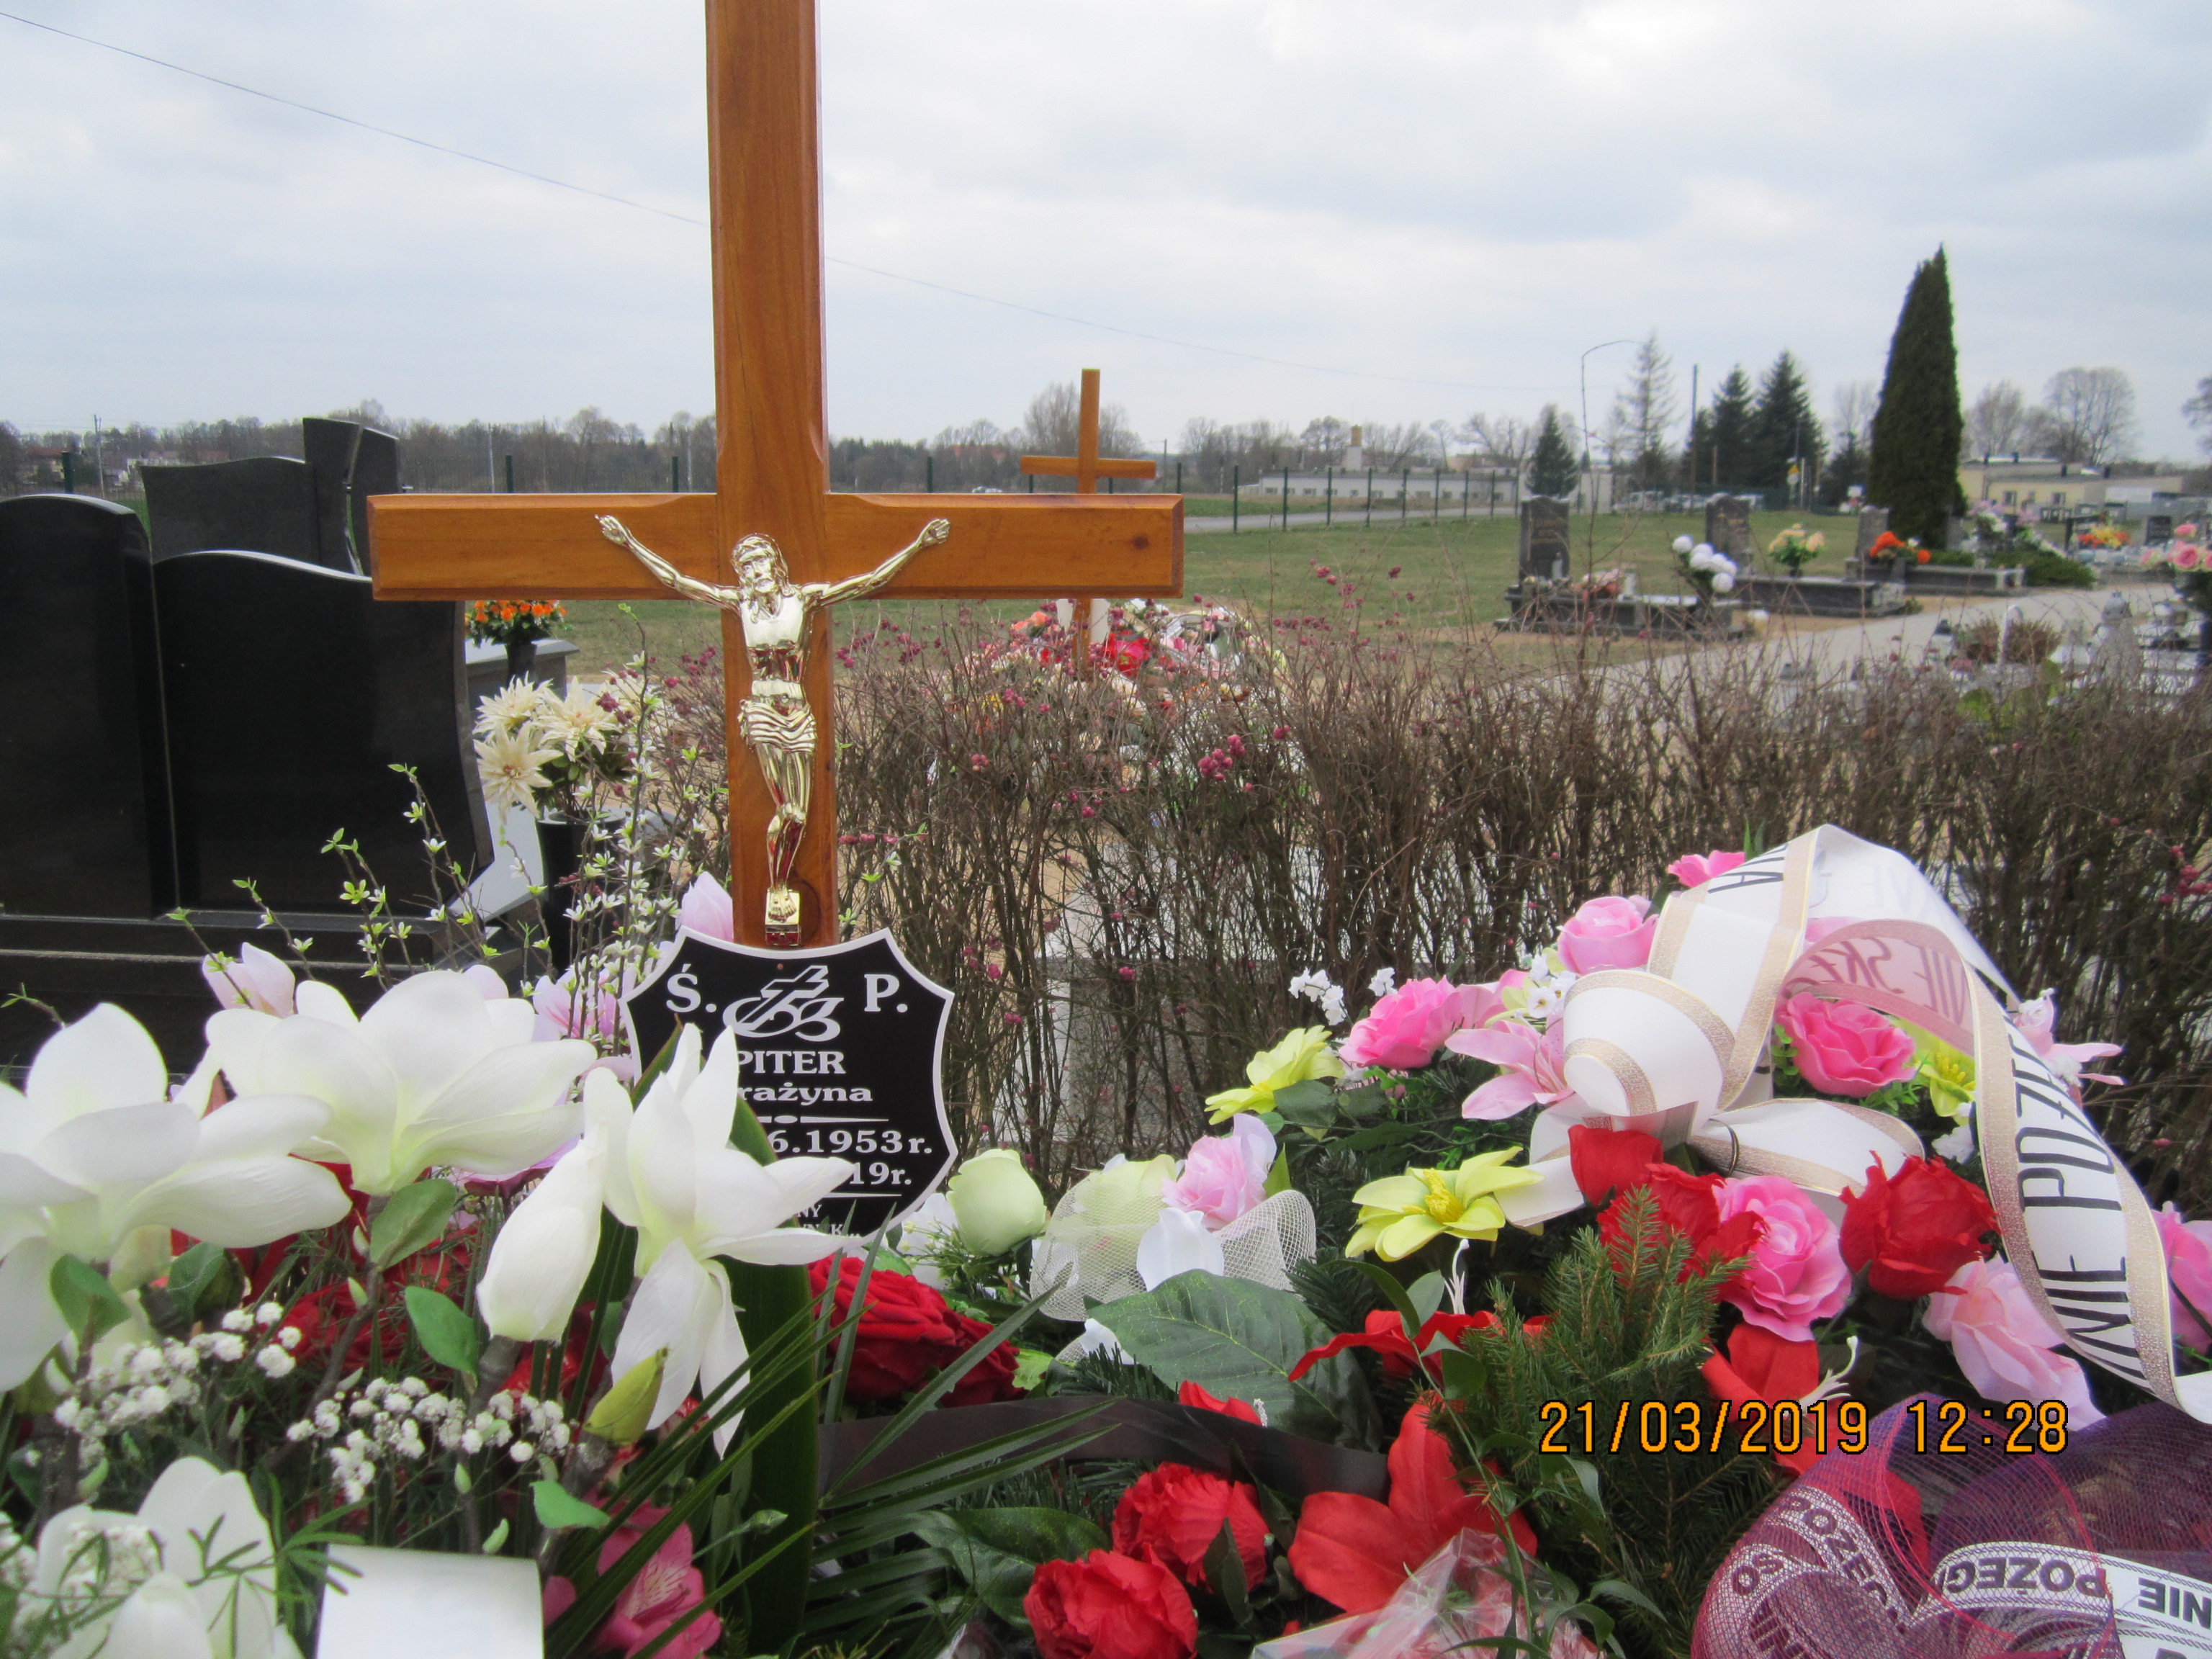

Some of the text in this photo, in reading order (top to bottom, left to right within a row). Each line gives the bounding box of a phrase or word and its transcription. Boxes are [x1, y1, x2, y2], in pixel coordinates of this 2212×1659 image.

[665, 963, 908, 1013] Ś. P.
[737, 1082, 873, 1107] rażyna
[767, 1130, 932, 1154] 6.1953r.
[849, 1162, 912, 1185] 19r.
